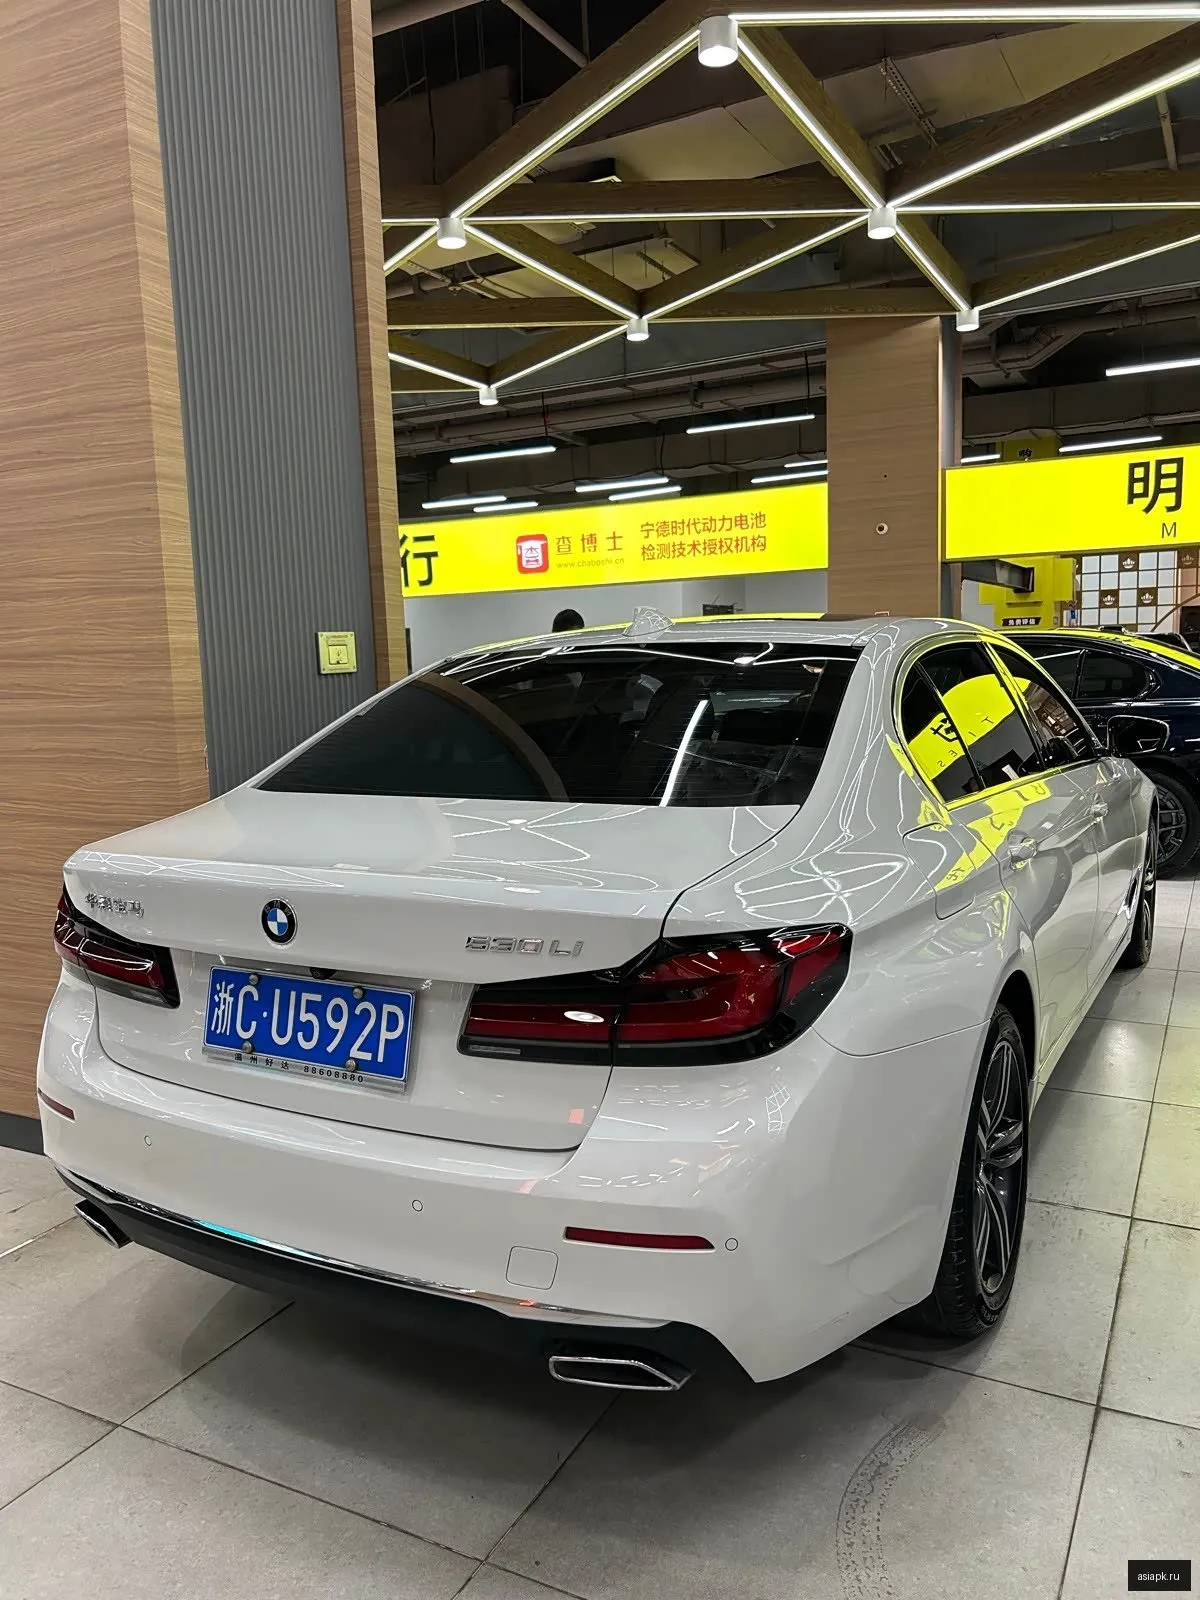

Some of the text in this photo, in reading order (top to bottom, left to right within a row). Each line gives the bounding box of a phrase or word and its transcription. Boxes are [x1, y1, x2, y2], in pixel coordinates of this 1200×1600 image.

[1127, 457, 1184, 515] 明
[640, 511, 767, 539] 宁德时代动力电池
[1161, 522, 1177, 539] M
[556, 531, 623, 555] 查博士
[641, 534, 767, 561] 检测技术授权机构
[400, 534, 439, 588] 行
[556, 558, 625, 569] www.chaboshi.cn
[211, 980, 405, 1063] 浙C·U592P
[303, 1065, 364, 1083] 88608880
